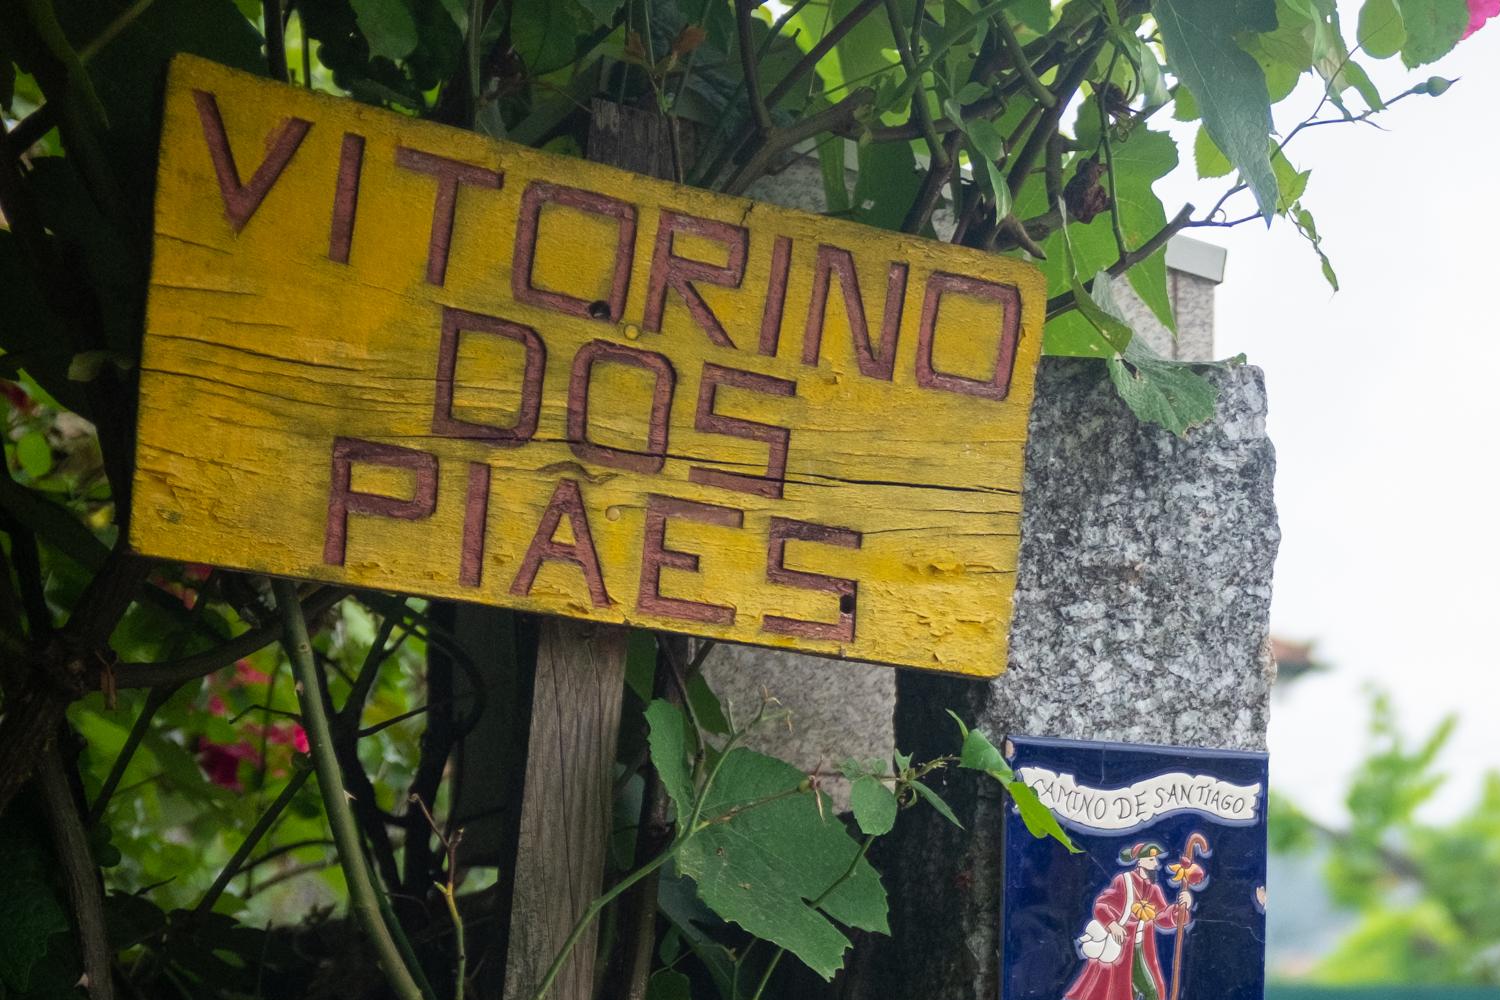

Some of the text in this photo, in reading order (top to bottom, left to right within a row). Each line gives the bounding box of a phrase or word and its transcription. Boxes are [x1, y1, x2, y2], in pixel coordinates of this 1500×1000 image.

[192, 89, 1020, 400] VITORINO
[430, 307, 798, 500] DOS
[1113, 791, 1147, 820] DE
[1154, 782, 1245, 814] SANTIAGO
